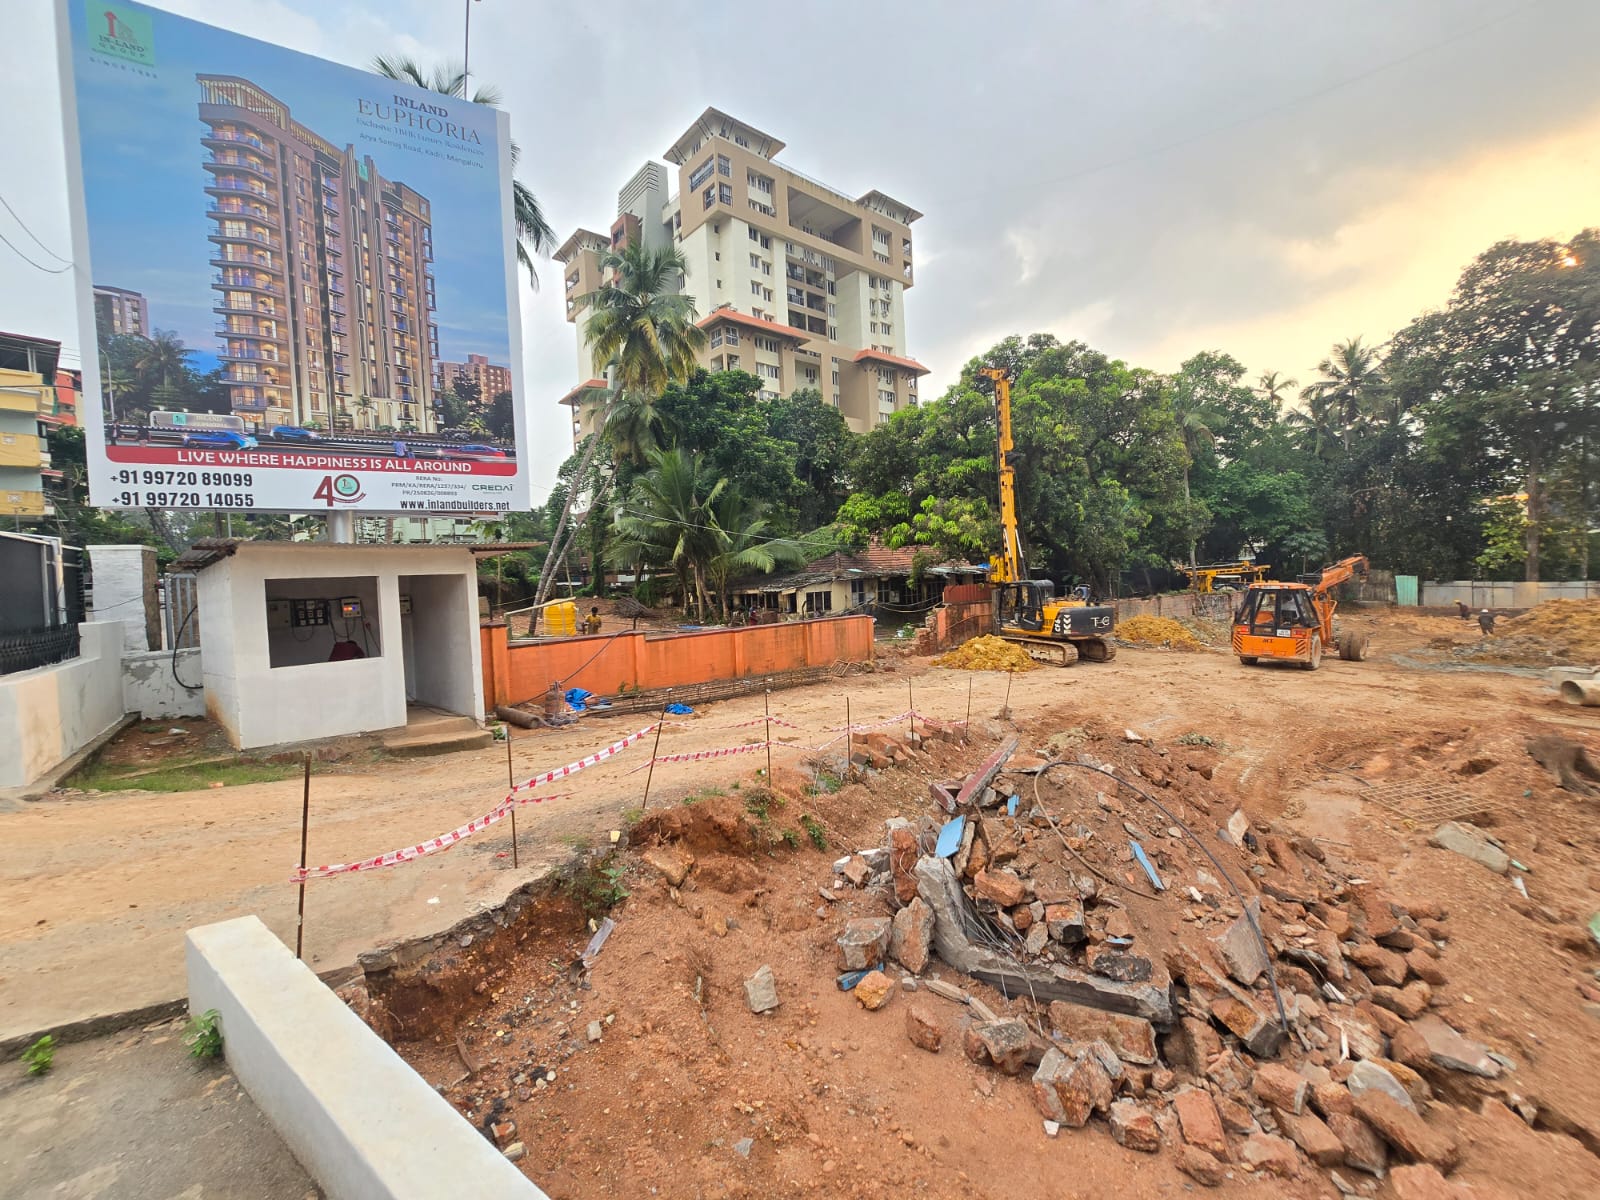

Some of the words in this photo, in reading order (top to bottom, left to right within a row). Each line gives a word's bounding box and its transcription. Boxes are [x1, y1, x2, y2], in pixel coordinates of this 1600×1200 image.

[393, 94, 448, 118] INLAND
[357, 98, 482, 145] EUPHORIA
[177, 450, 215, 463] LIVE
[219, 452, 279, 466] WHERE
[282, 455, 367, 470] HAPPINESS
[371, 458, 382, 469] IS
[385, 459, 411, 471] ALL
[414, 461, 472, 472] AROUND
[110, 470, 138, 485] +91
[143, 471, 197, 486] 99720
[202, 472, 253, 487] 89099
[472, 483, 513, 491] CREDAI
[112, 491, 140, 506] +91
[146, 492, 200, 507] 99720
[206, 493, 254, 507] 14055
[400, 499, 510, 511] www.inlandbuilders.net
